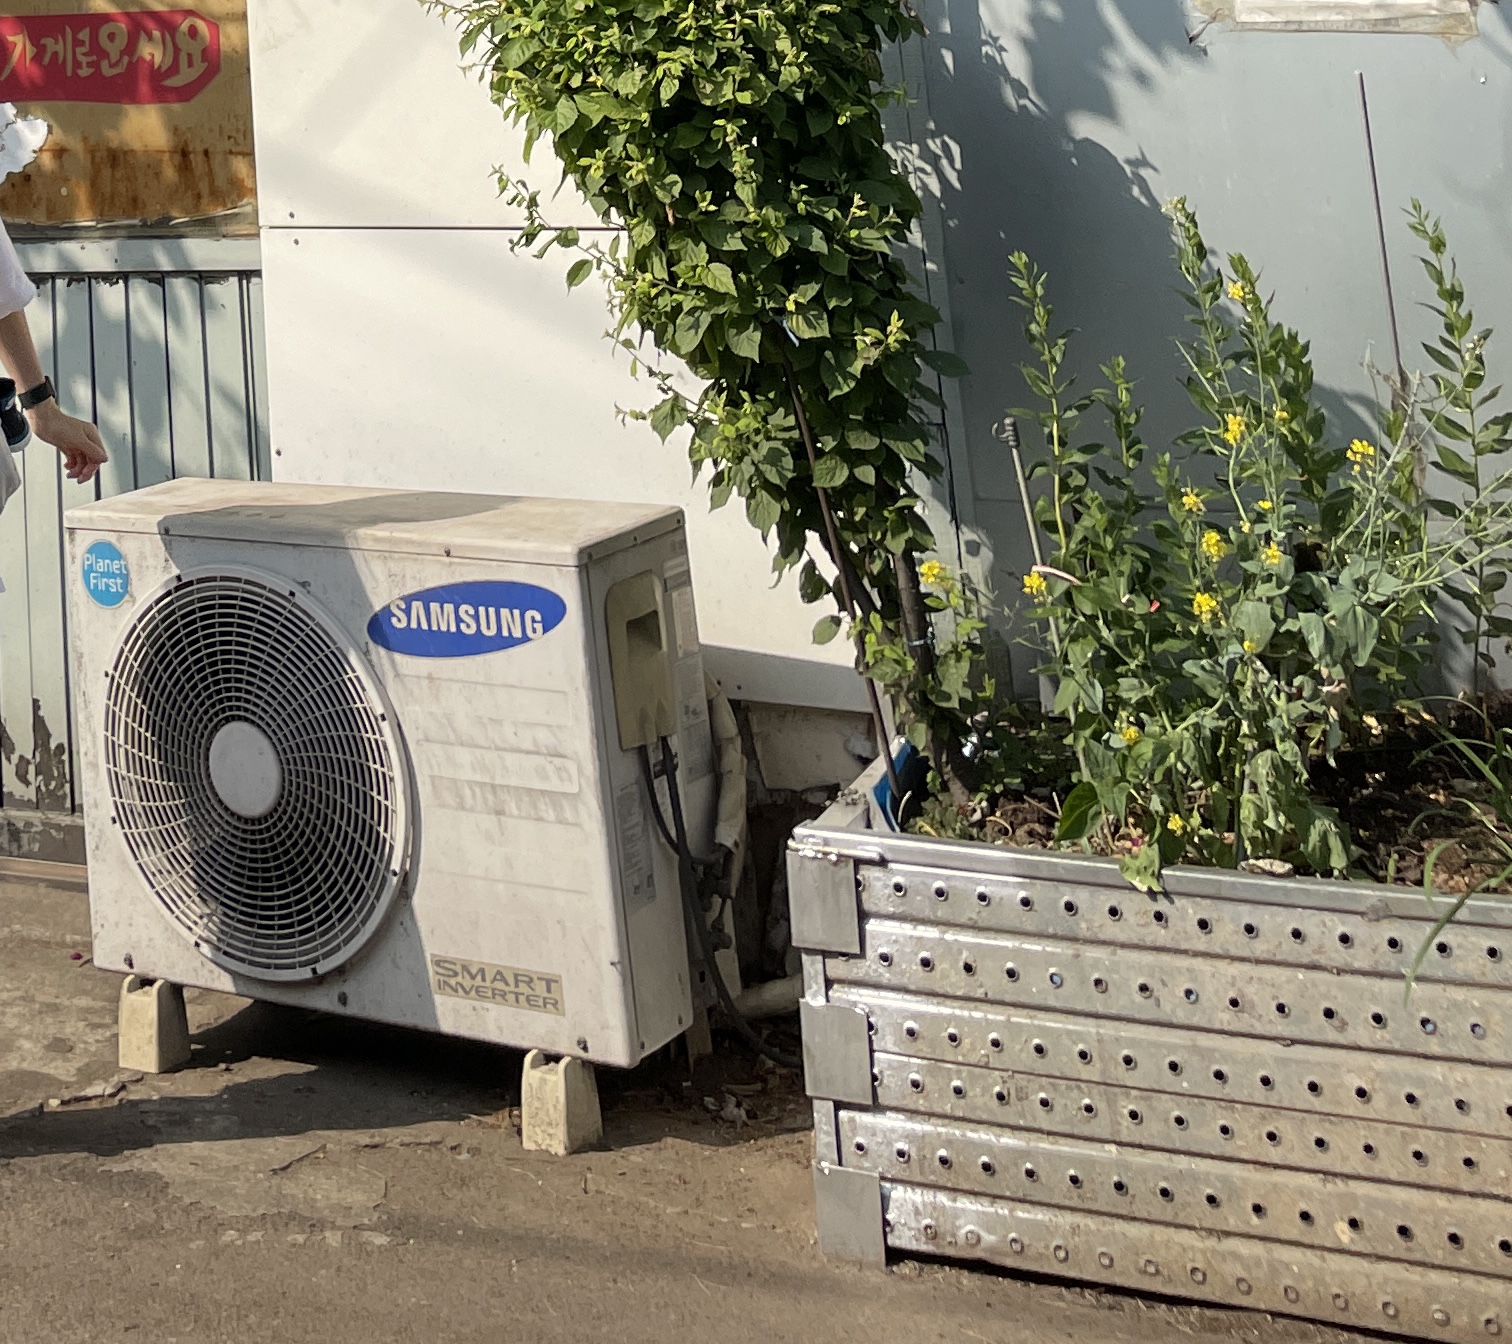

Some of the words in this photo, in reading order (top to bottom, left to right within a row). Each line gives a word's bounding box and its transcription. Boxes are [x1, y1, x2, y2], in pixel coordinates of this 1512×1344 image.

[84, 553, 128, 574] Planet
[89, 572, 124, 593] First
[389, 598, 545, 641] SAMSUNG
[434, 959, 560, 995] SMART
[437, 978, 561, 1012] INVERTER
